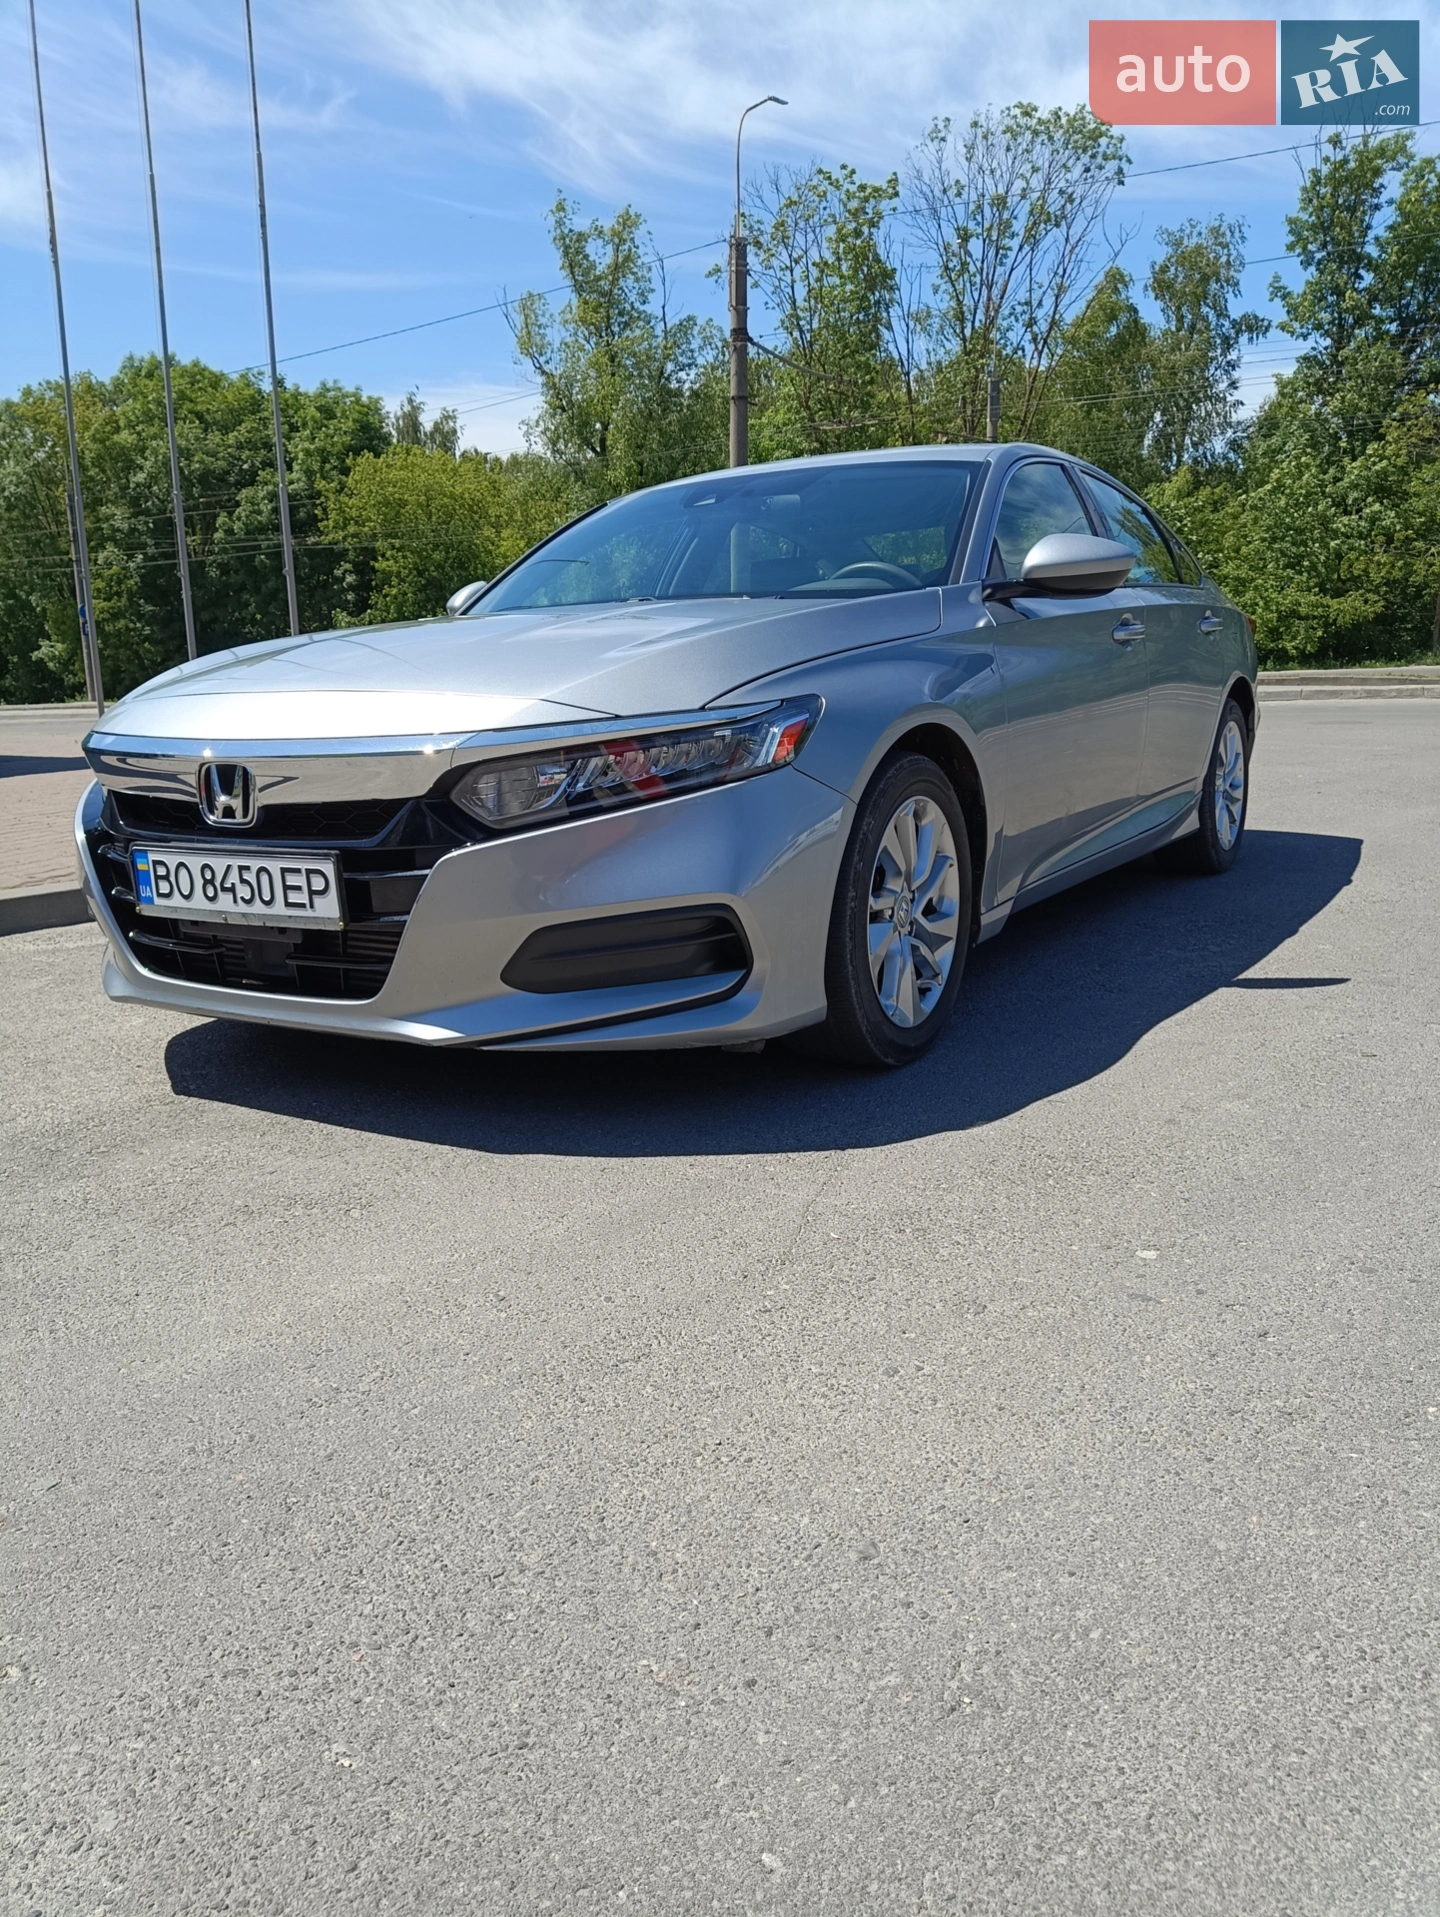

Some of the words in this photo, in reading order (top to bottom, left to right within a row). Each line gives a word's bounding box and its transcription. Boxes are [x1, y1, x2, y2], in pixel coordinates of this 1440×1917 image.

[140, 885, 152, 898] UA
[151, 859, 194, 900] BO
[200, 862, 275, 906] 8450
[280, 866, 330, 909] EP
